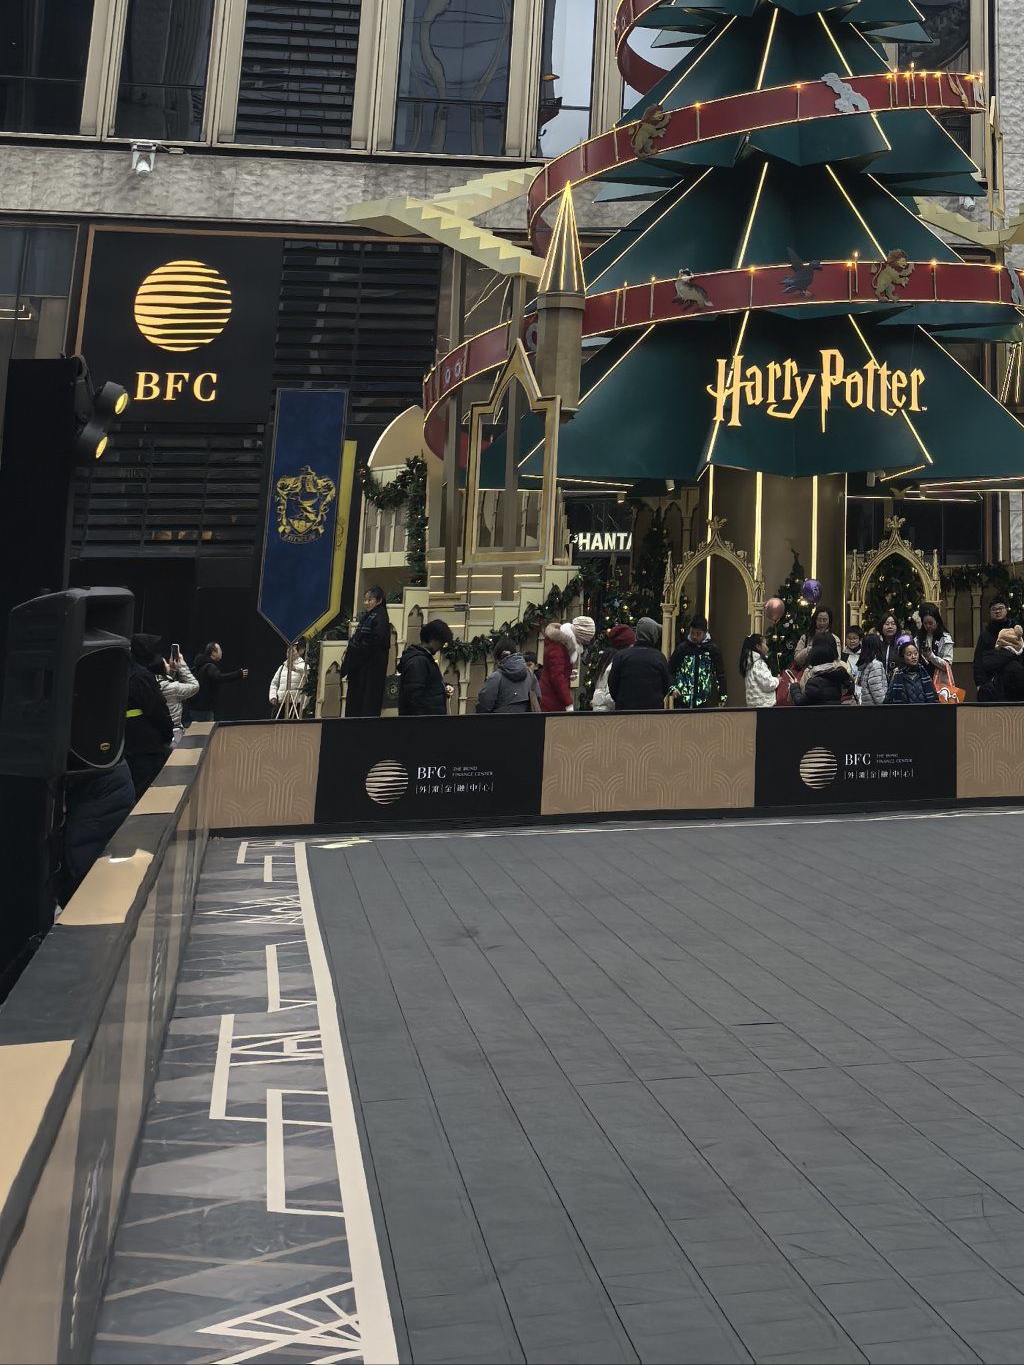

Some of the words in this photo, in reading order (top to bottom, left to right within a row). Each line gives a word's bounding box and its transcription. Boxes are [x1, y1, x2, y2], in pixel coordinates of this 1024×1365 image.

[134, 371, 217, 402] BFC
[706, 355, 815, 426] Harry
[819, 349, 925, 433] Potter
[845, 753, 871, 766] BFC
[417, 765, 447, 780] BFC
